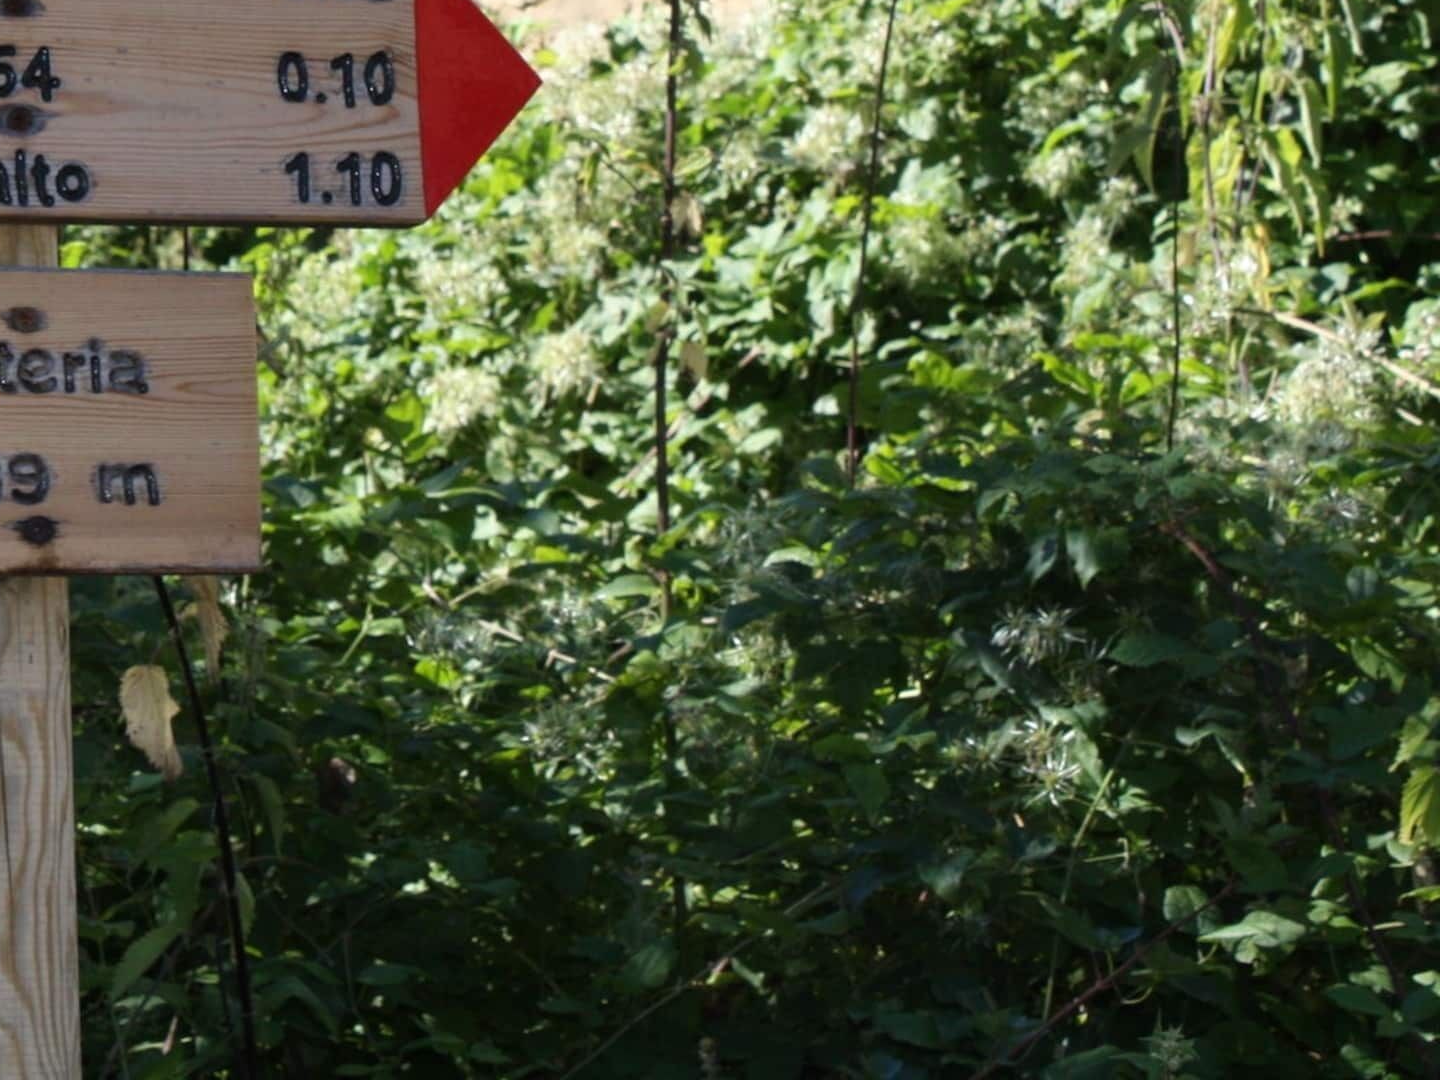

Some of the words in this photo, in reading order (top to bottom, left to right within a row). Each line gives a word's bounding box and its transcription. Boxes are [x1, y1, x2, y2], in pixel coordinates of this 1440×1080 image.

[277, 50, 395, 109] 0.10
[284, 151, 403, 207] 1.10
[96, 461, 160, 506] m
